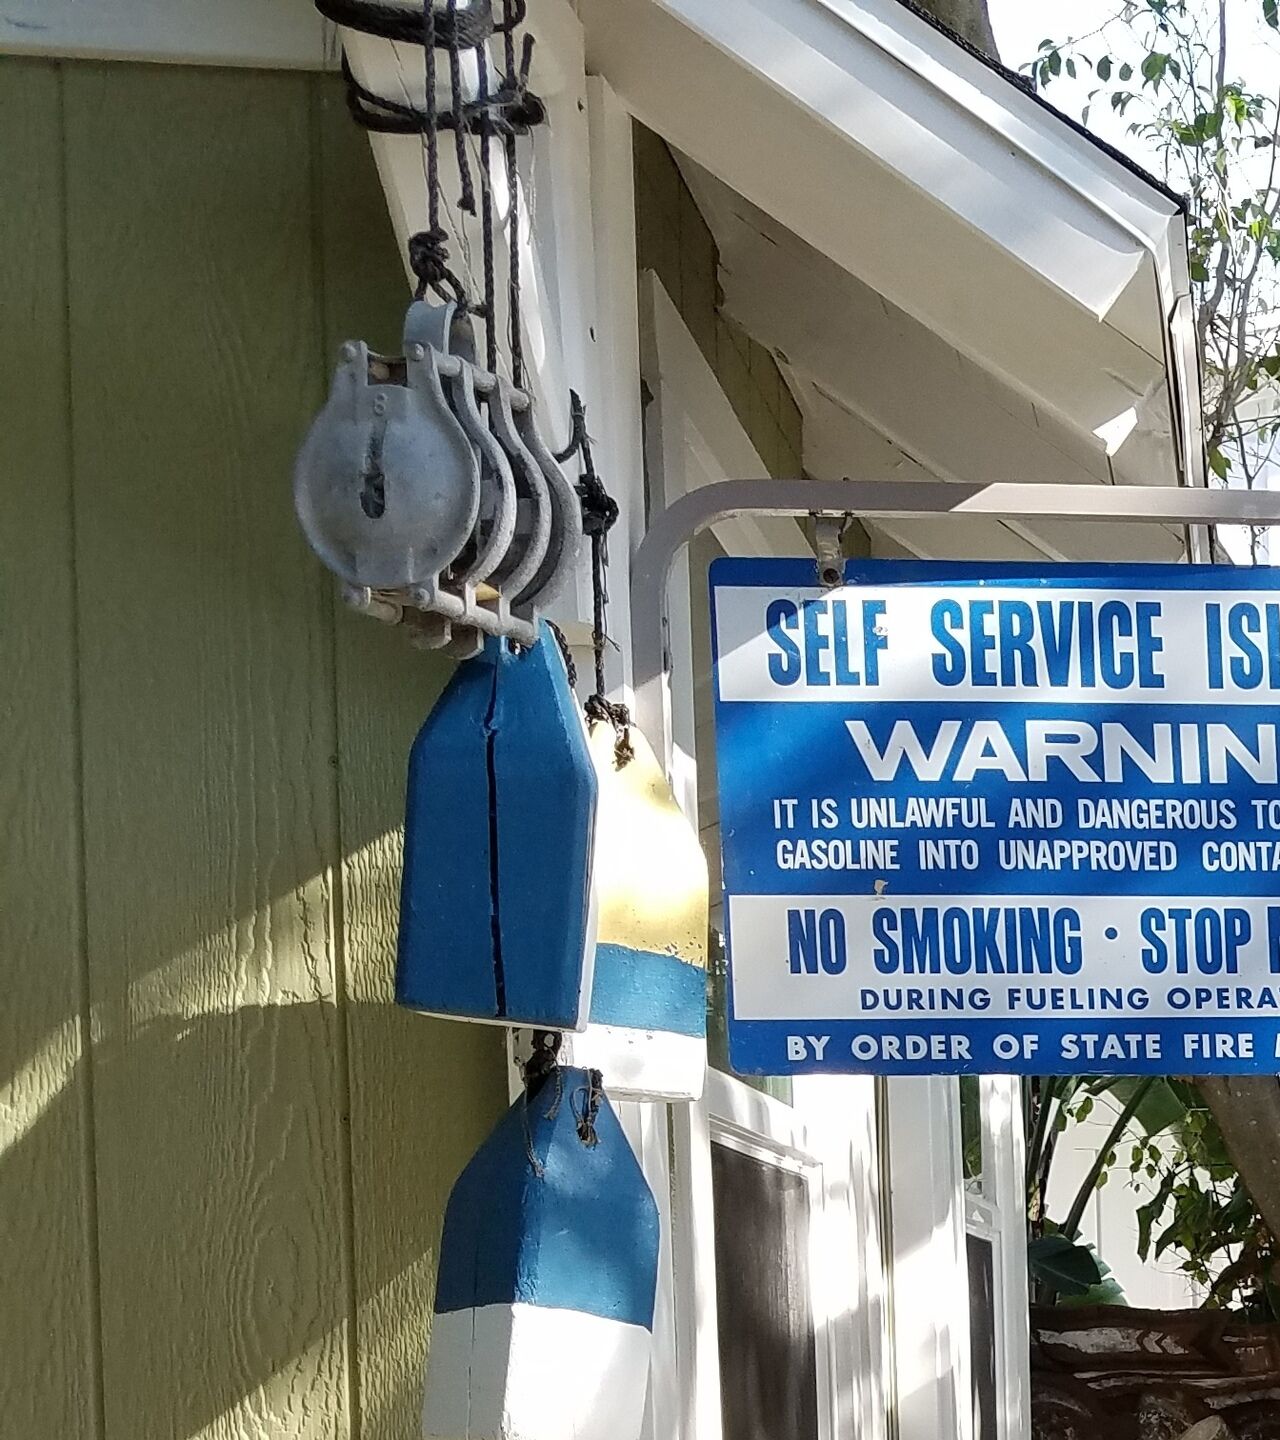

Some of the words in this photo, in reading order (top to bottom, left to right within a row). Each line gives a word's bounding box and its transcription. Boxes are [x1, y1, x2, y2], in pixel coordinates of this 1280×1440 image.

[765, 599, 889, 687] SELF
[930, 598, 1165, 690] SERVICE
[773, 798, 799, 829] IT
[811, 798, 839, 829] IS
[850, 797, 996, 829] UNLAWFUL
[1008, 797, 1063, 829] AND
[1077, 798, 1237, 830] DANGEROUS
[776, 839, 900, 870] GASOLINE
[918, 839, 979, 870] INTO
[998, 839, 1177, 871] UNAPPROVED
[787, 908, 847, 975] NO
[872, 906, 1083, 975] SMOKING
[1140, 907, 1252, 975] STOP
[860, 987, 991, 1011] DURING
[1007, 987, 1150, 1011] FUELING
[787, 1035, 831, 1061] BY
[851, 1034, 973, 1061] ORDER
[992, 1033, 1039, 1060] OF
[1060, 1033, 1162, 1060] STATE
[1183, 1033, 1254, 1059] FIRE
